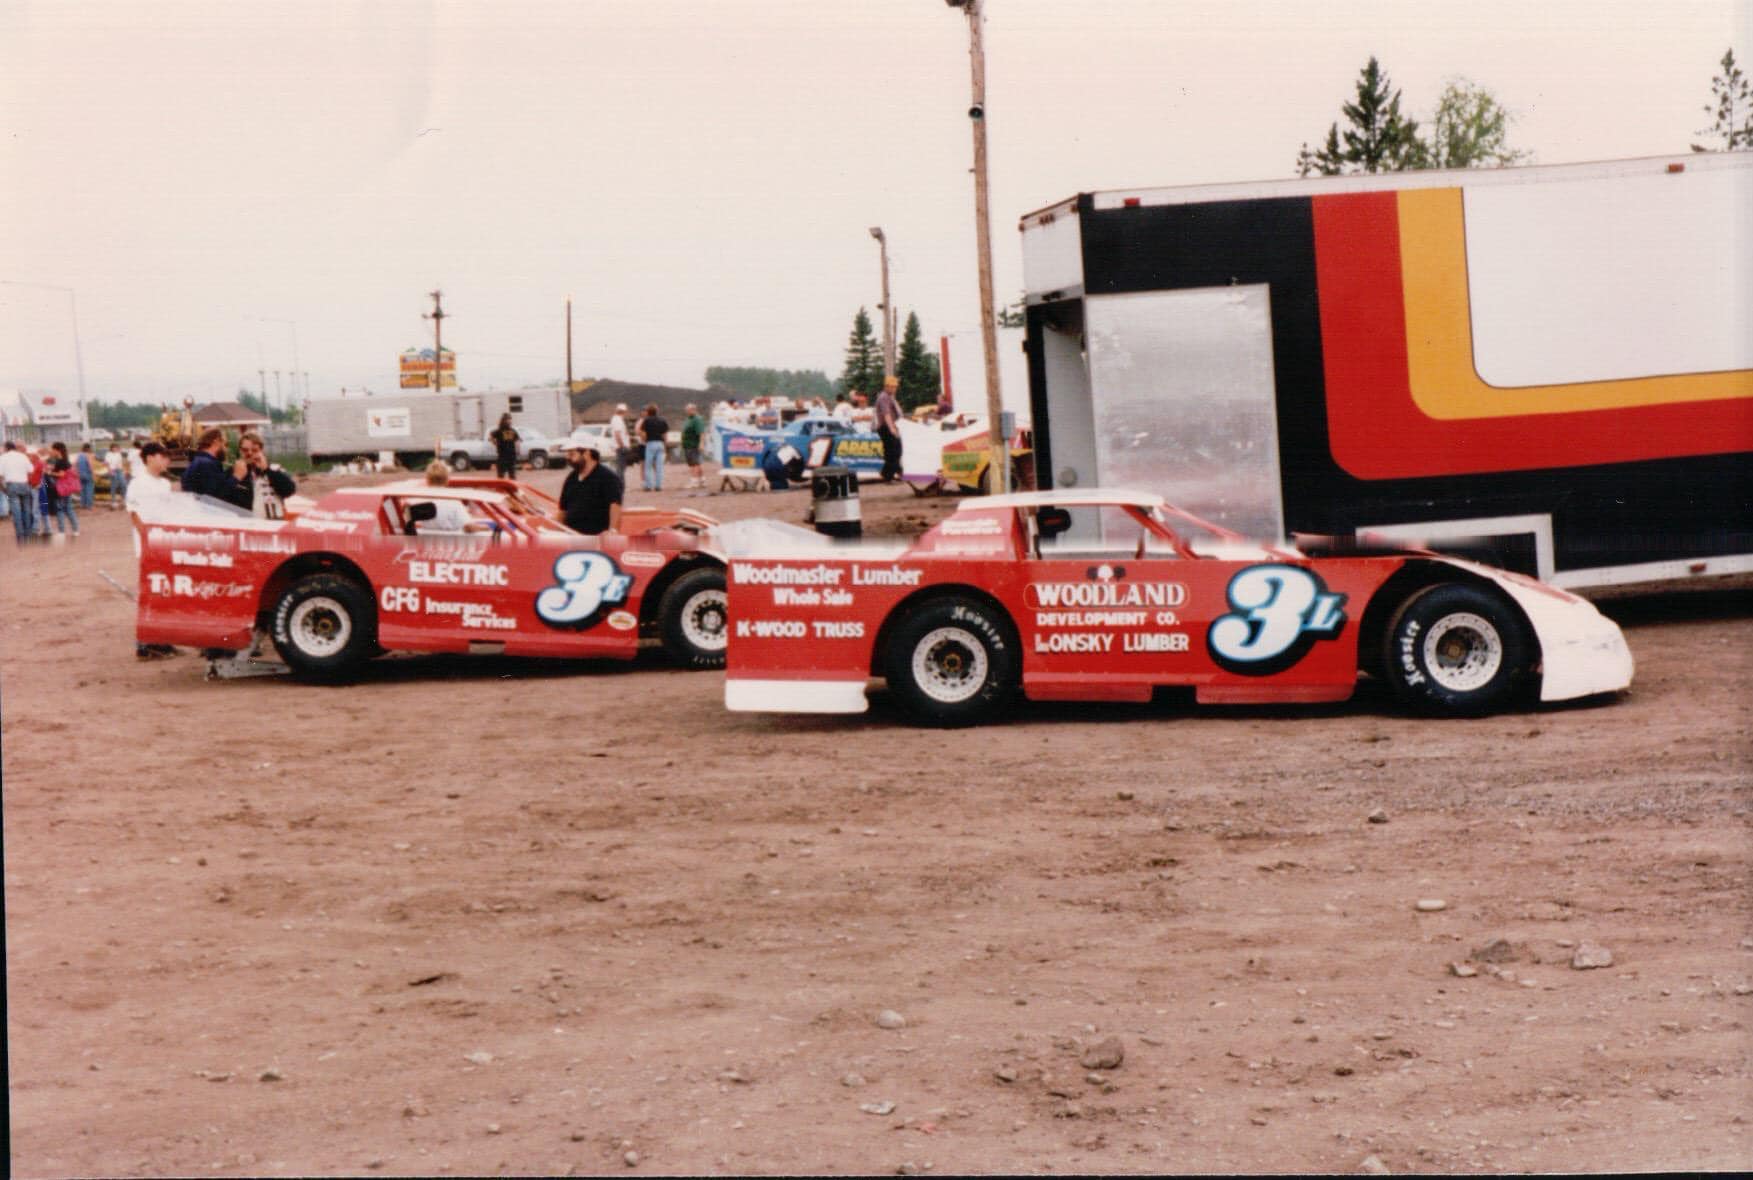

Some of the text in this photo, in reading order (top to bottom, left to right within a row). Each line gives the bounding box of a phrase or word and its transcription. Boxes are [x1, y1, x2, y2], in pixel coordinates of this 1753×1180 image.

[807, 437, 833, 468] 1
[409, 561, 509, 586] ELECTRIC
[733, 563, 923, 586] Woodmaster Lumber
[773, 588, 853, 606] Whole Sale
[1035, 583, 1185, 607] WOODLAND
[425, 597, 493, 615] Insurance
[461, 613, 518, 630] Services
[1036, 612, 1181, 626] DEVELOPMENT CO.
[812, 621, 865, 638] TRUSS
[1034, 633, 1190, 653] LONSKY LUMBER
